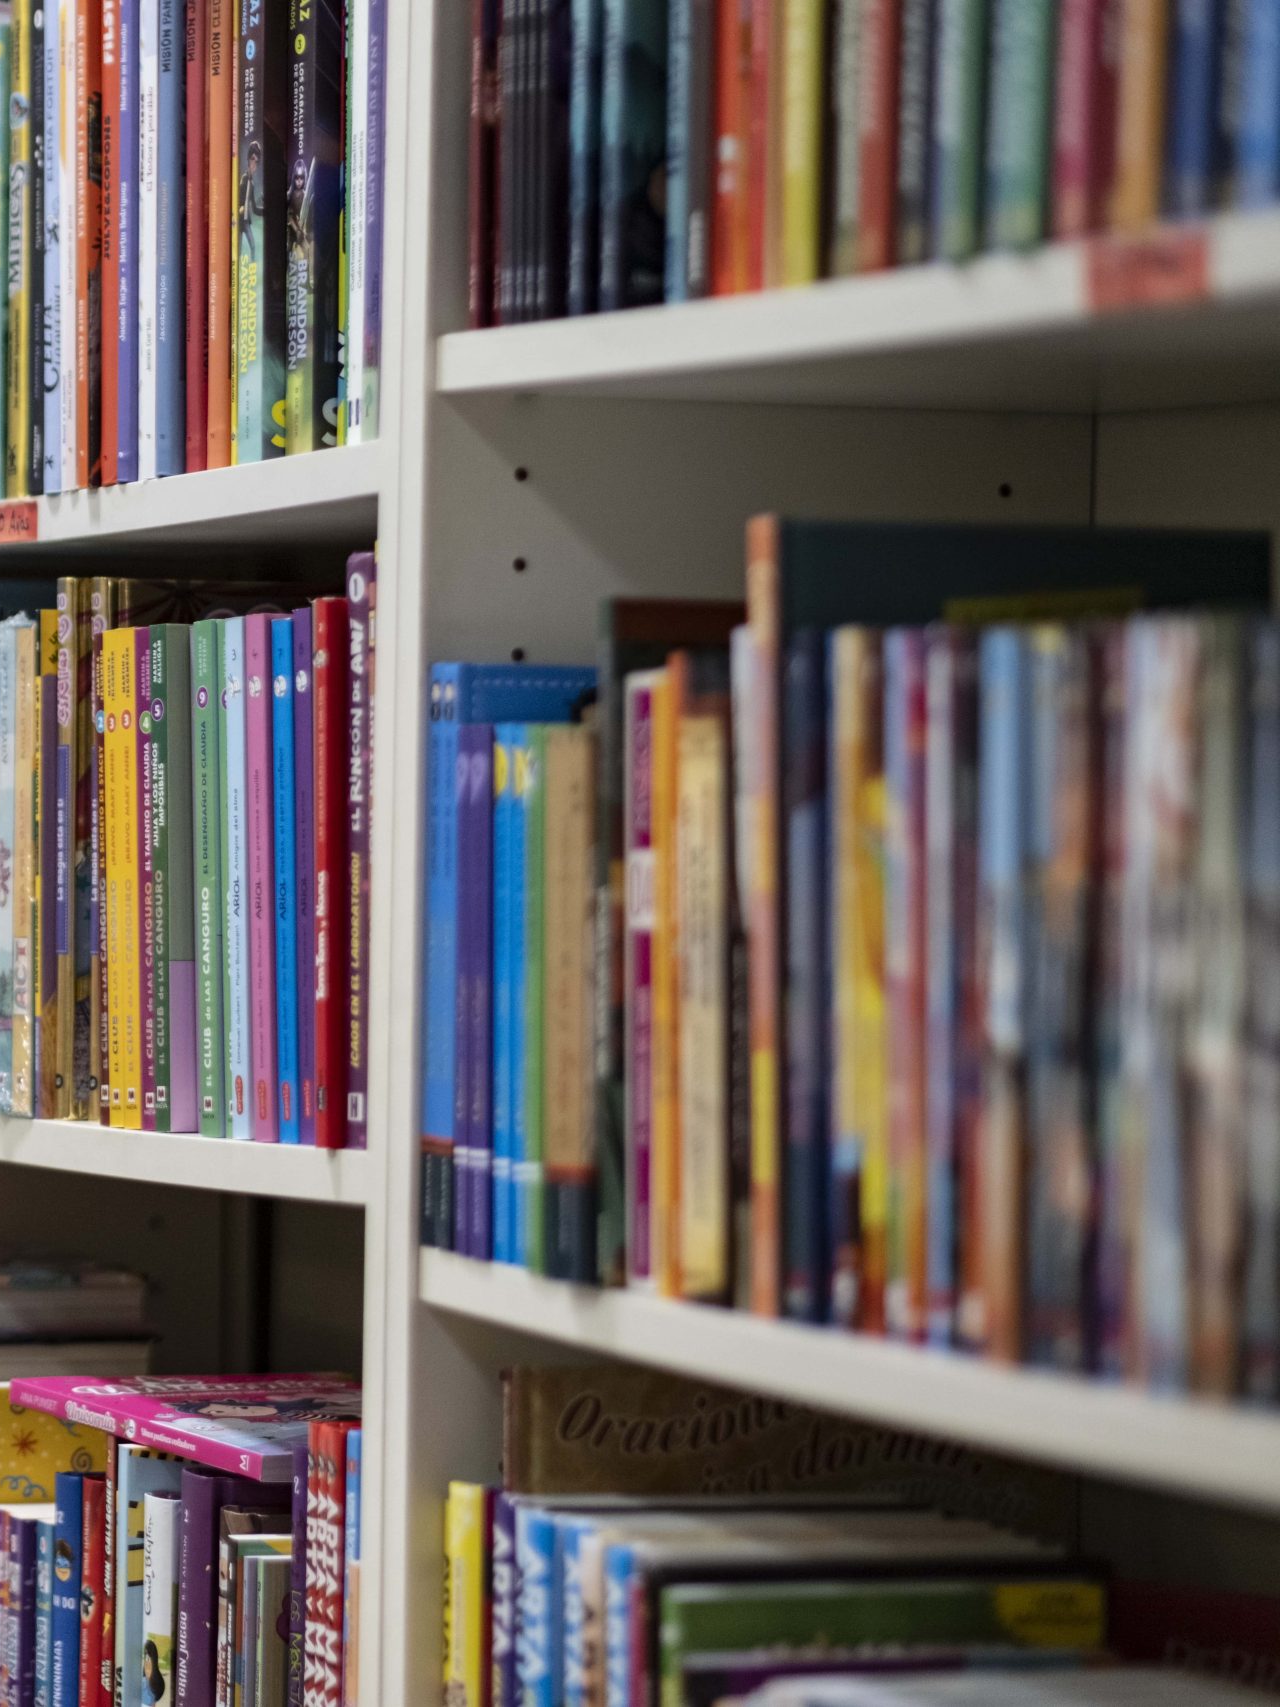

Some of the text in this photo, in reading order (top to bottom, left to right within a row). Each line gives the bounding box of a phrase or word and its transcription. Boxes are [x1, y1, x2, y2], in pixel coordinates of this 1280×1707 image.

[370, 33, 379, 71] ANA
[368, 114, 377, 166] MEJOR
[240, 254, 249, 374] SANDERSON
[247, 261, 257, 362] BRANDON
[287, 250, 298, 371] SANDERSON
[296, 258, 308, 360] BRANDON
[351, 680, 361, 702] DE
[150, 742, 158, 778] NIÑOS
[157, 762, 165, 827] IMPOSIBLES
[201, 789, 209, 860] DESENGAÑO
[350, 807, 361, 832] EL
[57, 852, 66, 885] magia
[99, 877, 107, 963] CANGURO
[144, 882, 152, 968] CANGURO
[155, 869, 163, 955] CANGURO
[201, 887, 210, 975] CANGURO
[349, 851, 360, 969] LABORATORIO!
[349, 974, 360, 992] EL
[349, 995, 360, 1017] EN
[100, 1012, 108, 1053] CLUB
[145, 1018, 153, 1060] CLUB
[157, 1006, 165, 1048] CLUB
[204, 1027, 212, 1070] CLUB
[104, 1478, 112, 1596] JOHN GALLAGHER
[144, 1514, 154, 1569] Blyton
[326, 1493, 338, 1598] ARTA
[493, 1524, 513, 1658] ARTA
[178, 1658, 188, 1698] GRAN
